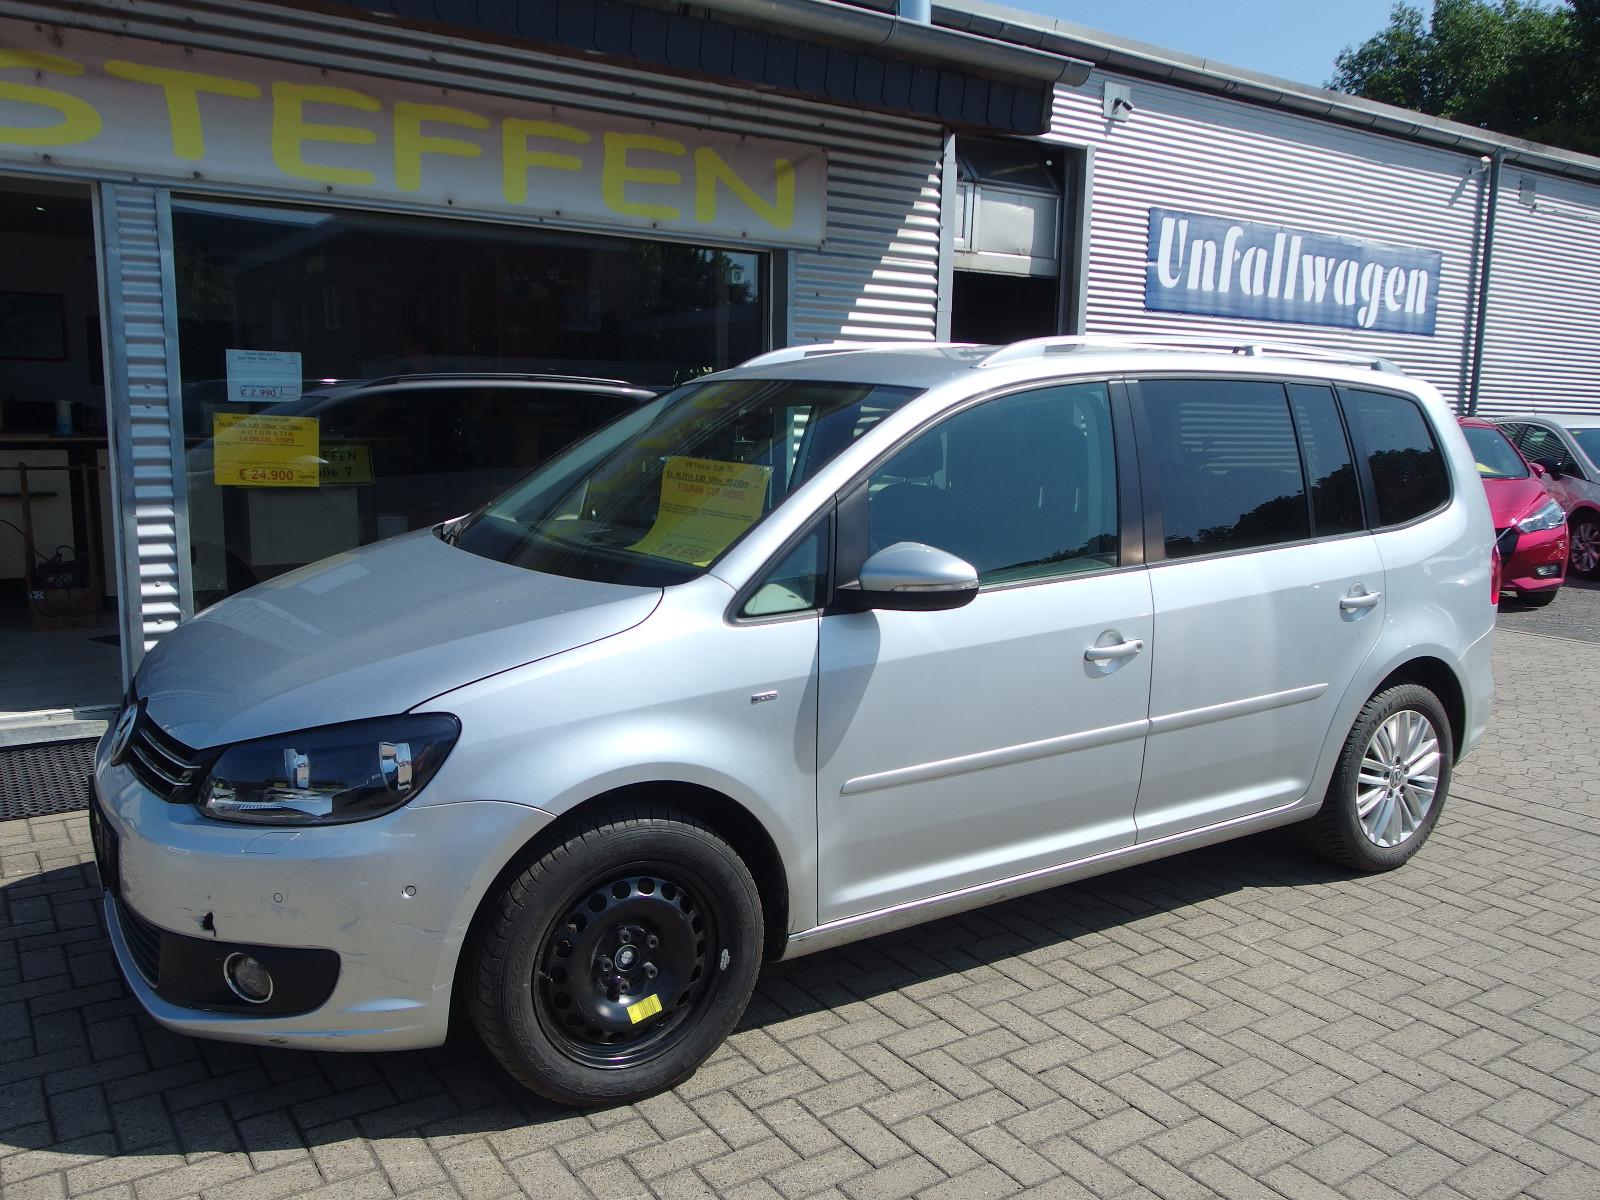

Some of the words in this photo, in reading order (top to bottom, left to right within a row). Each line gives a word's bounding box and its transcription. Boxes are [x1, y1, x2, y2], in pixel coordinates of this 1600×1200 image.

[0, 48, 797, 230] STEFFEN
[1157, 216, 1429, 329] Unfallwagen
[239, 468, 247, 480] €
[251, 468, 294, 481] 24.900
